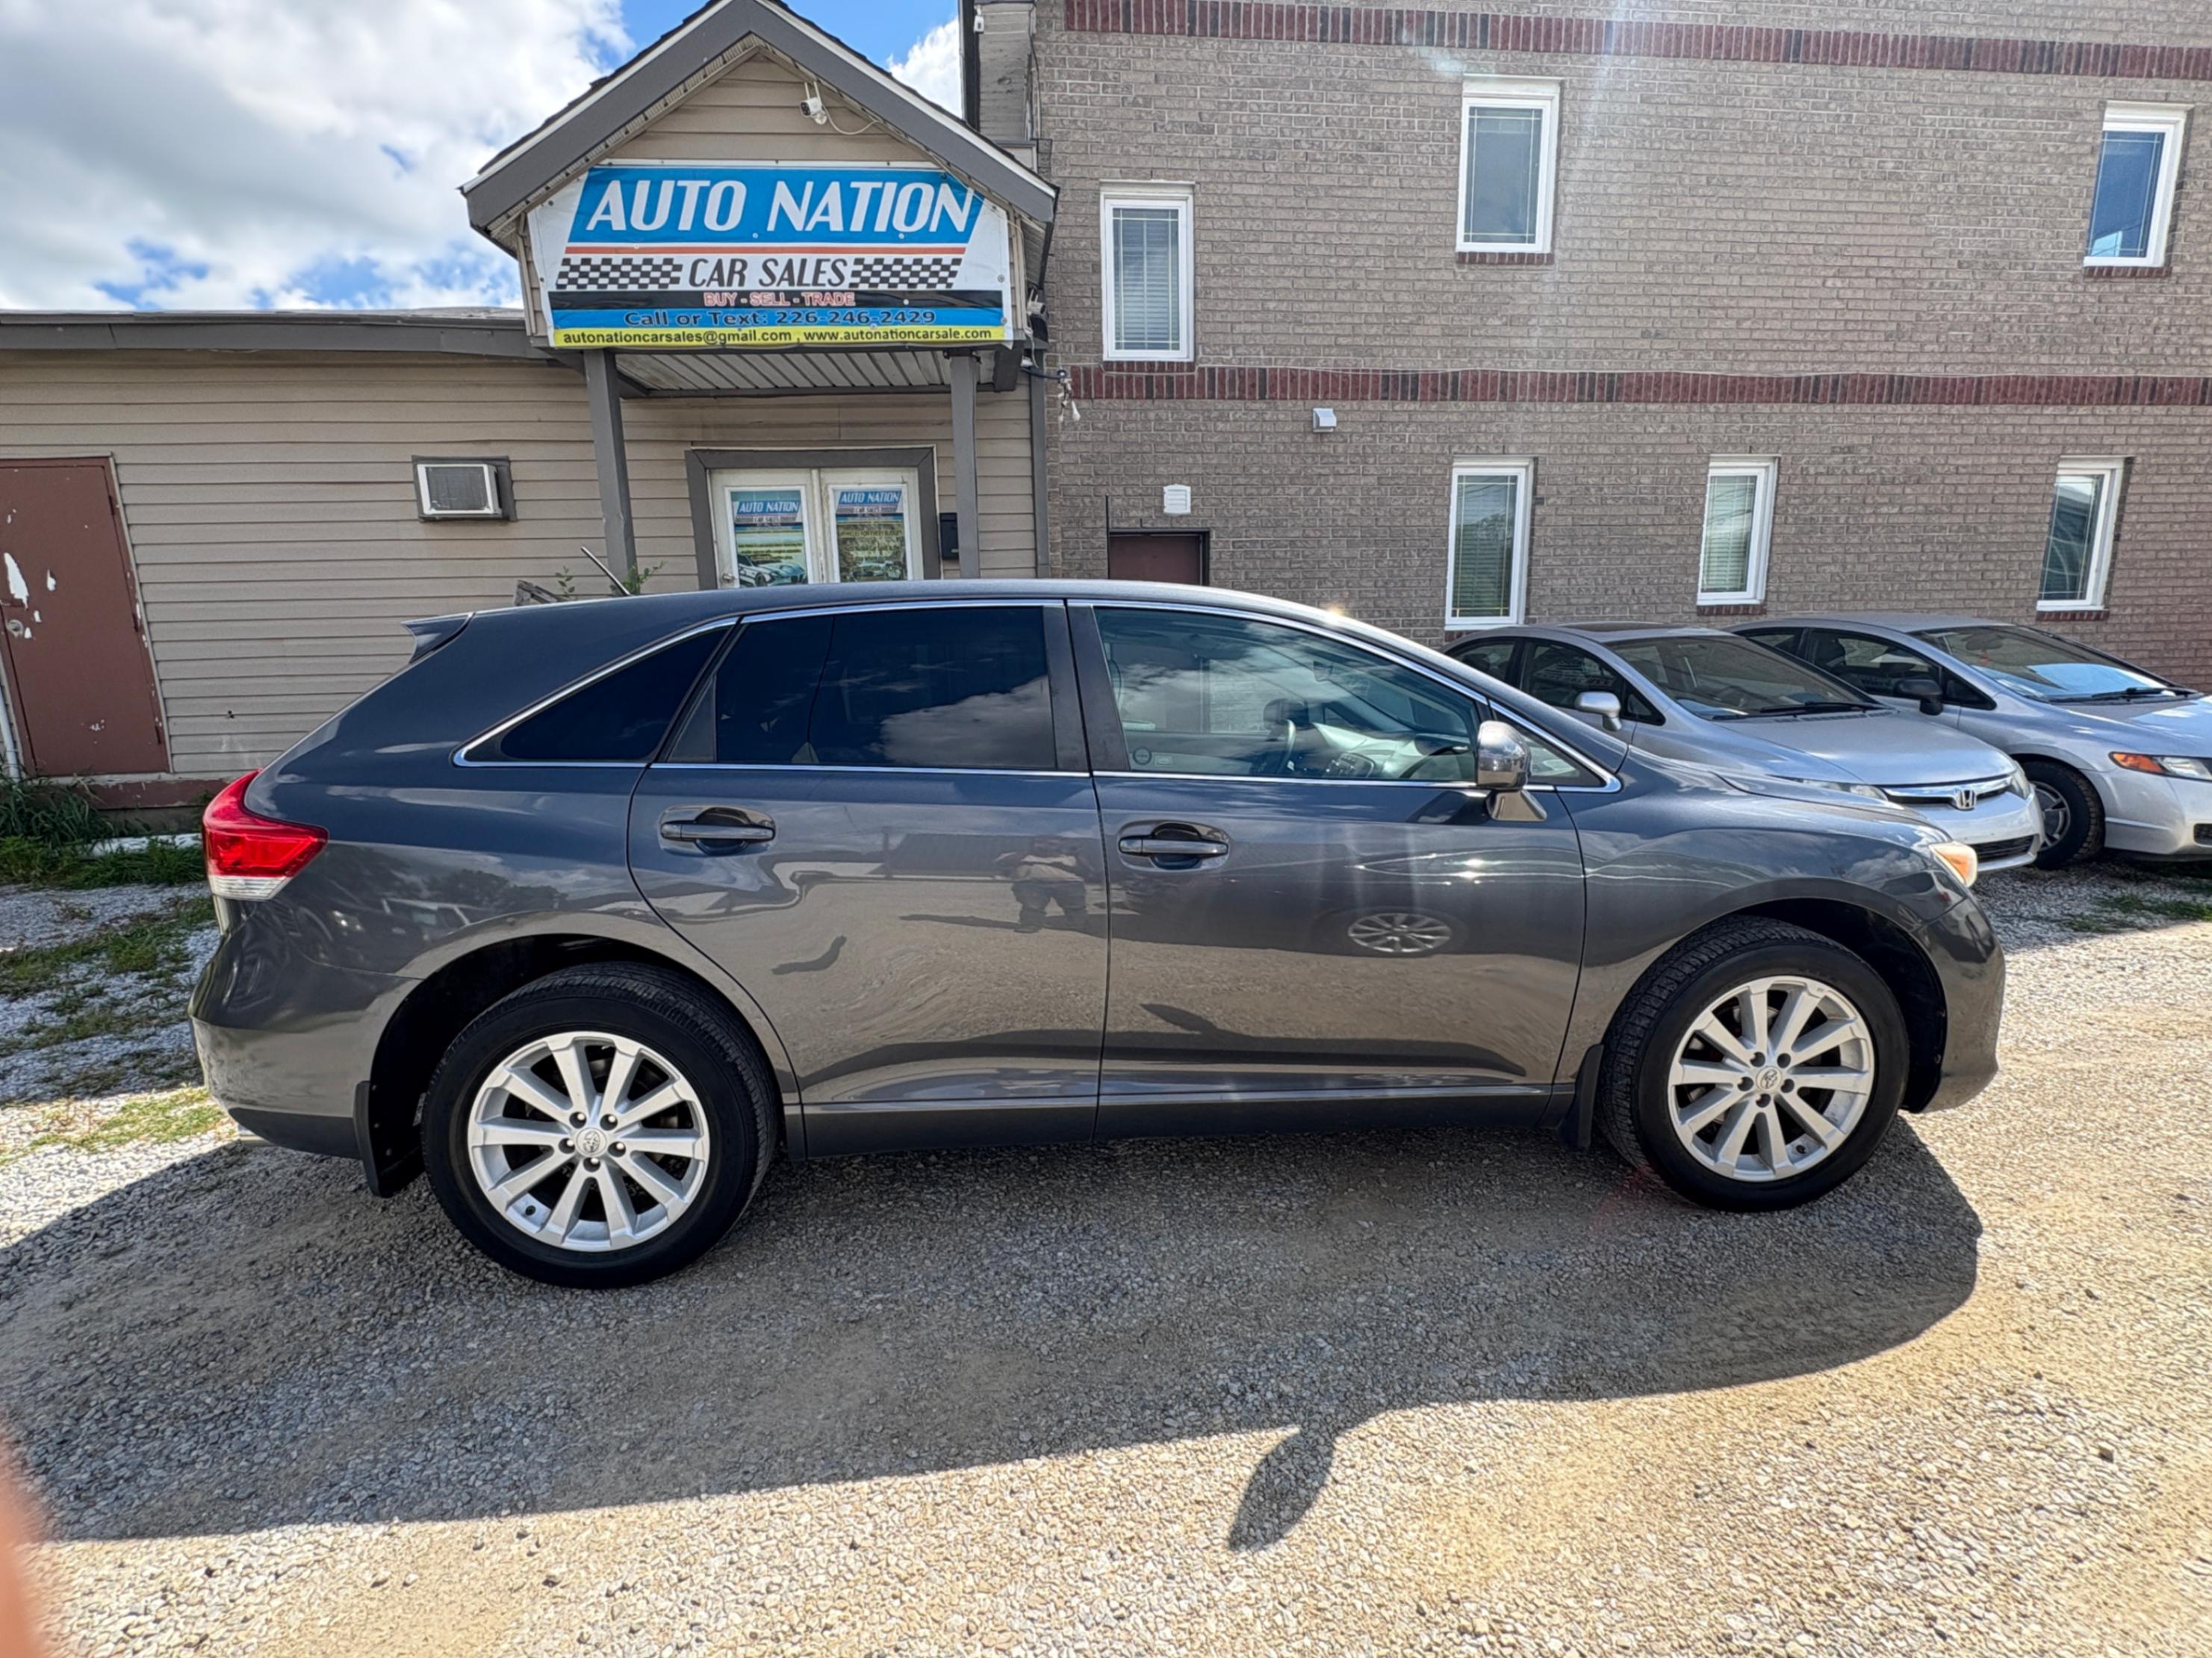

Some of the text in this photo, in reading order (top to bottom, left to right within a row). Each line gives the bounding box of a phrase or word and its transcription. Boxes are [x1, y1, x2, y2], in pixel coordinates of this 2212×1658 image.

[585, 180, 974, 232] AUTO NATION
[689, 258, 848, 287] CAR SALES
[703, 292, 738, 306] BUY
[749, 292, 790, 306] SELL
[801, 291, 855, 306] TRADE
[624, 311, 935, 326] Call or Text: 226-246-2429
[563, 330, 792, 346] autonationcarsales@gmail.com
[804, 328, 992, 341] www.autonationcarsale.com
[841, 491, 900, 503] AUTO NATION
[739, 501, 798, 512] AUTO NATION
